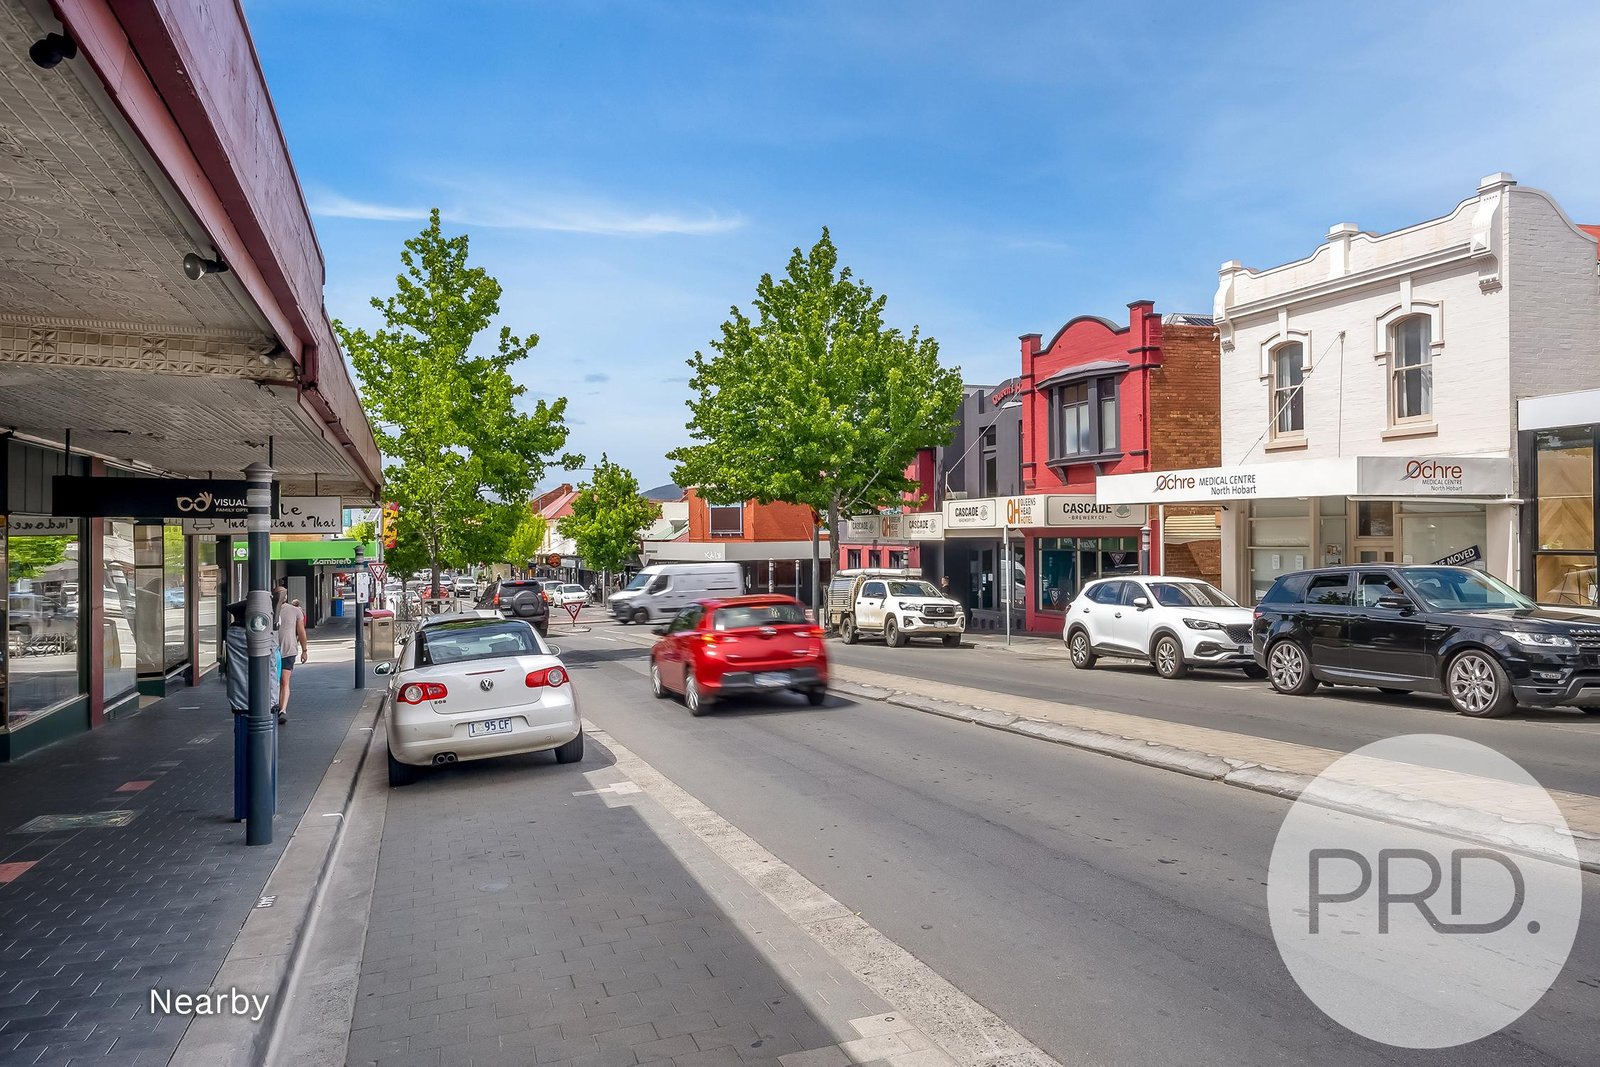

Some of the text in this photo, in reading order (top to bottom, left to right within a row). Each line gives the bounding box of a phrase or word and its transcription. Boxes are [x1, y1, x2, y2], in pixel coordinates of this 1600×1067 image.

[1199, 475, 1228, 487] MEDICAL
[1229, 474, 1256, 485] CENTRE
[1211, 484, 1257, 496] North Hobart
[1020, 497, 1036, 507] QUEENS
[1062, 502, 1113, 514] CASCADE
[954, 506, 979, 518] CASCADE
[1006, 498, 1021, 525] QH
[1020, 506, 1031, 516] HEAD
[306, 515, 336, 529] Thai
[908, 519, 929, 530] CASCADE
[312, 558, 352, 566] Zambrero
[1446, 548, 1476, 566] MOVED
[484, 721, 496, 732] 95
[498, 719, 510, 730] CF
